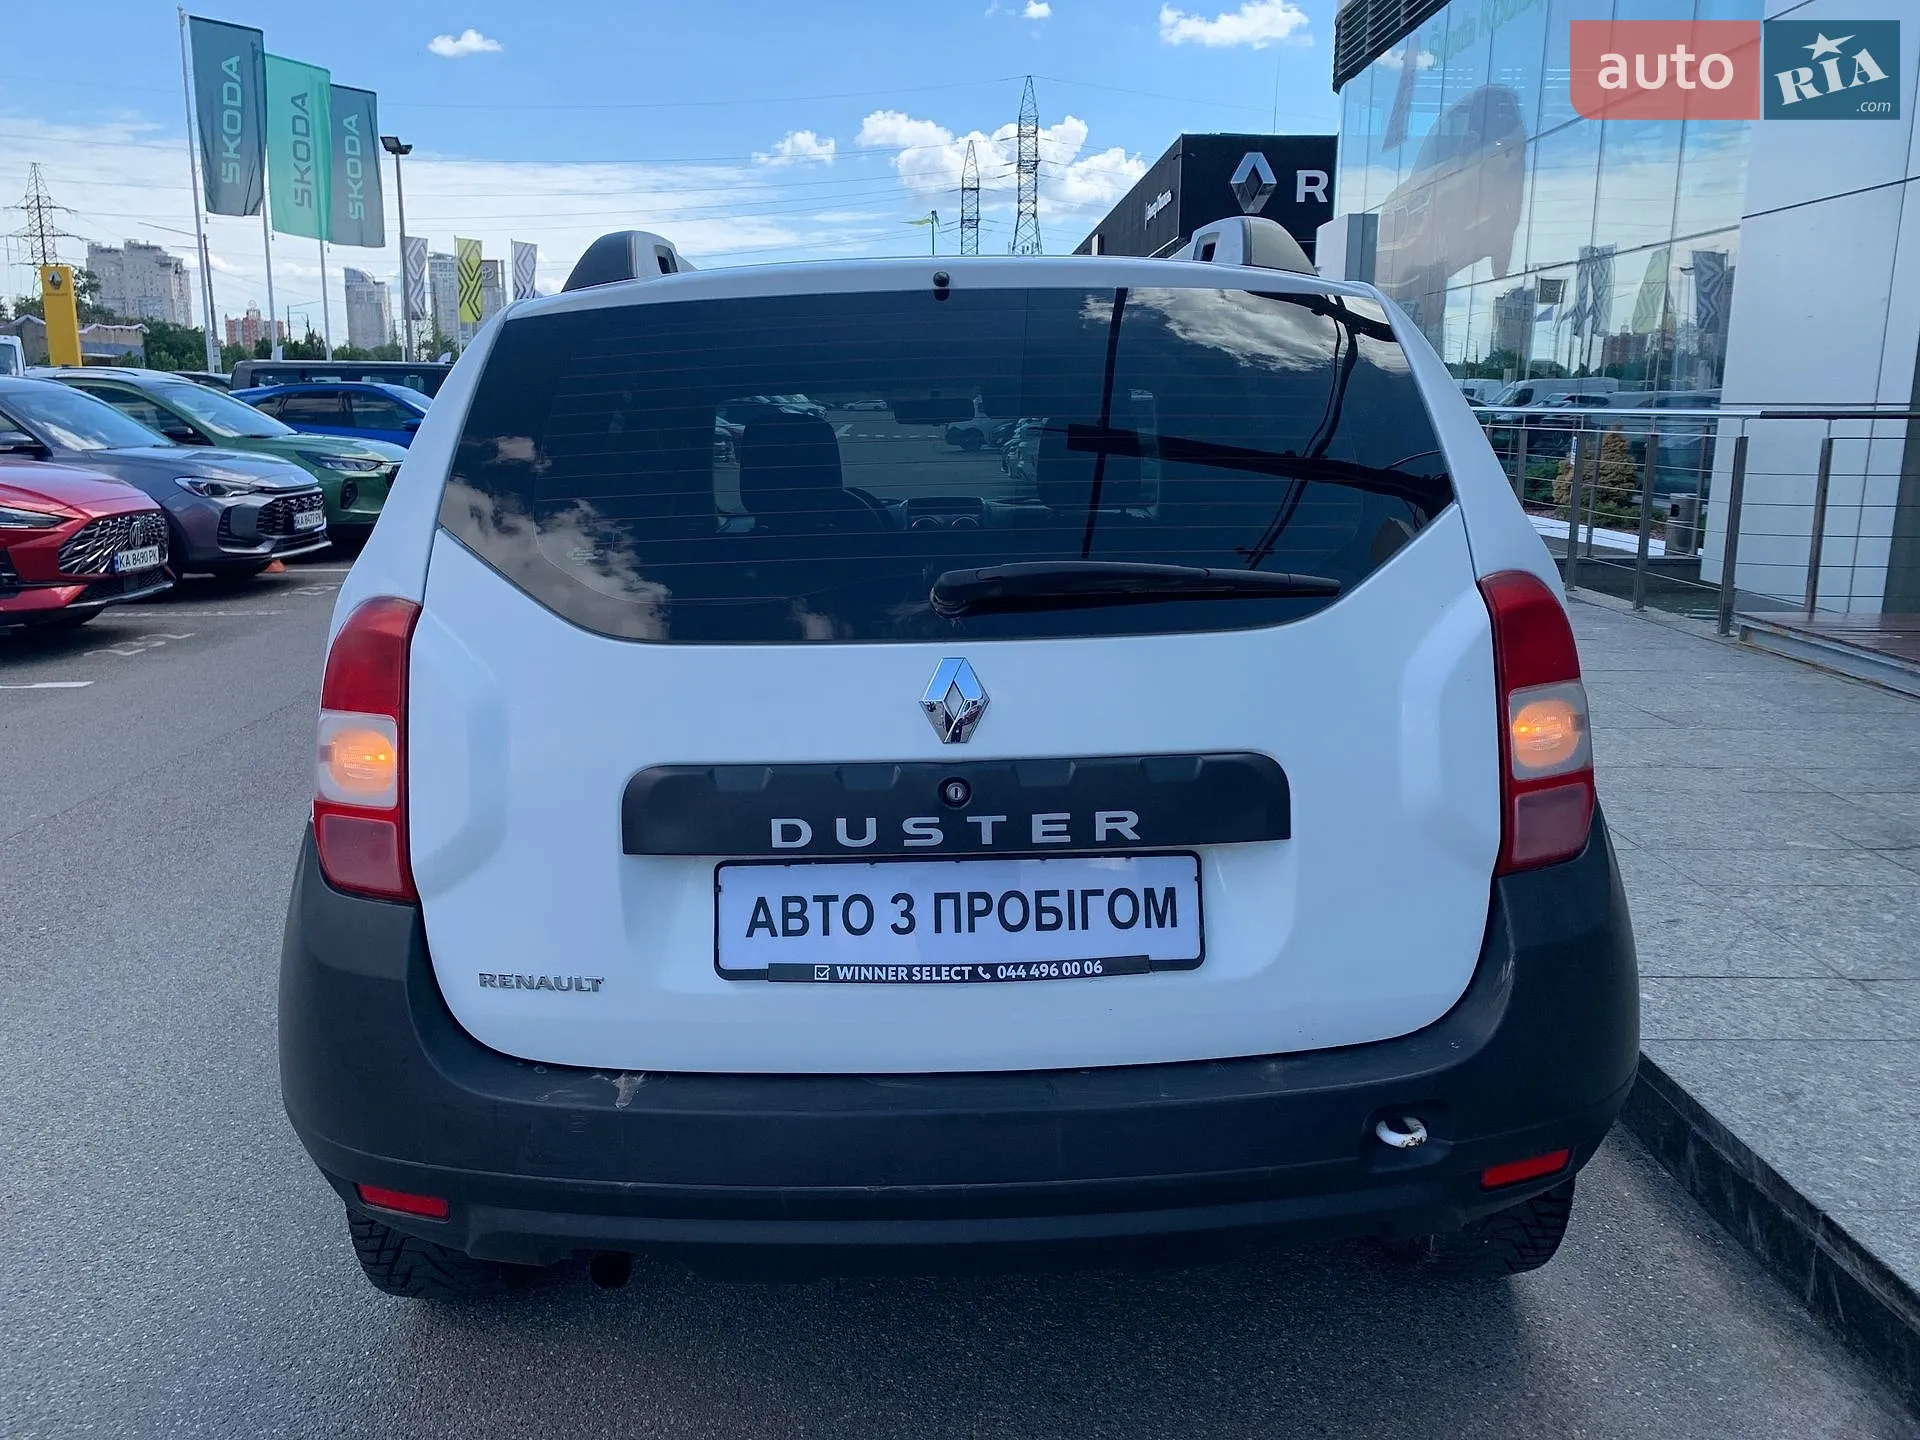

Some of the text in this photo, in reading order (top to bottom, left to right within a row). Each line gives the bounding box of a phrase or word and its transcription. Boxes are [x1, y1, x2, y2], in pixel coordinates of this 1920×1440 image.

[770, 810, 1141, 849] DUSTER
[745, 893, 875, 938] АВТО
[934, 886, 1178, 934] ПРОБІГОМ
[479, 972, 605, 993] RENAULT
[837, 960, 1103, 981] WINNER SELECT 044 496 00 06
